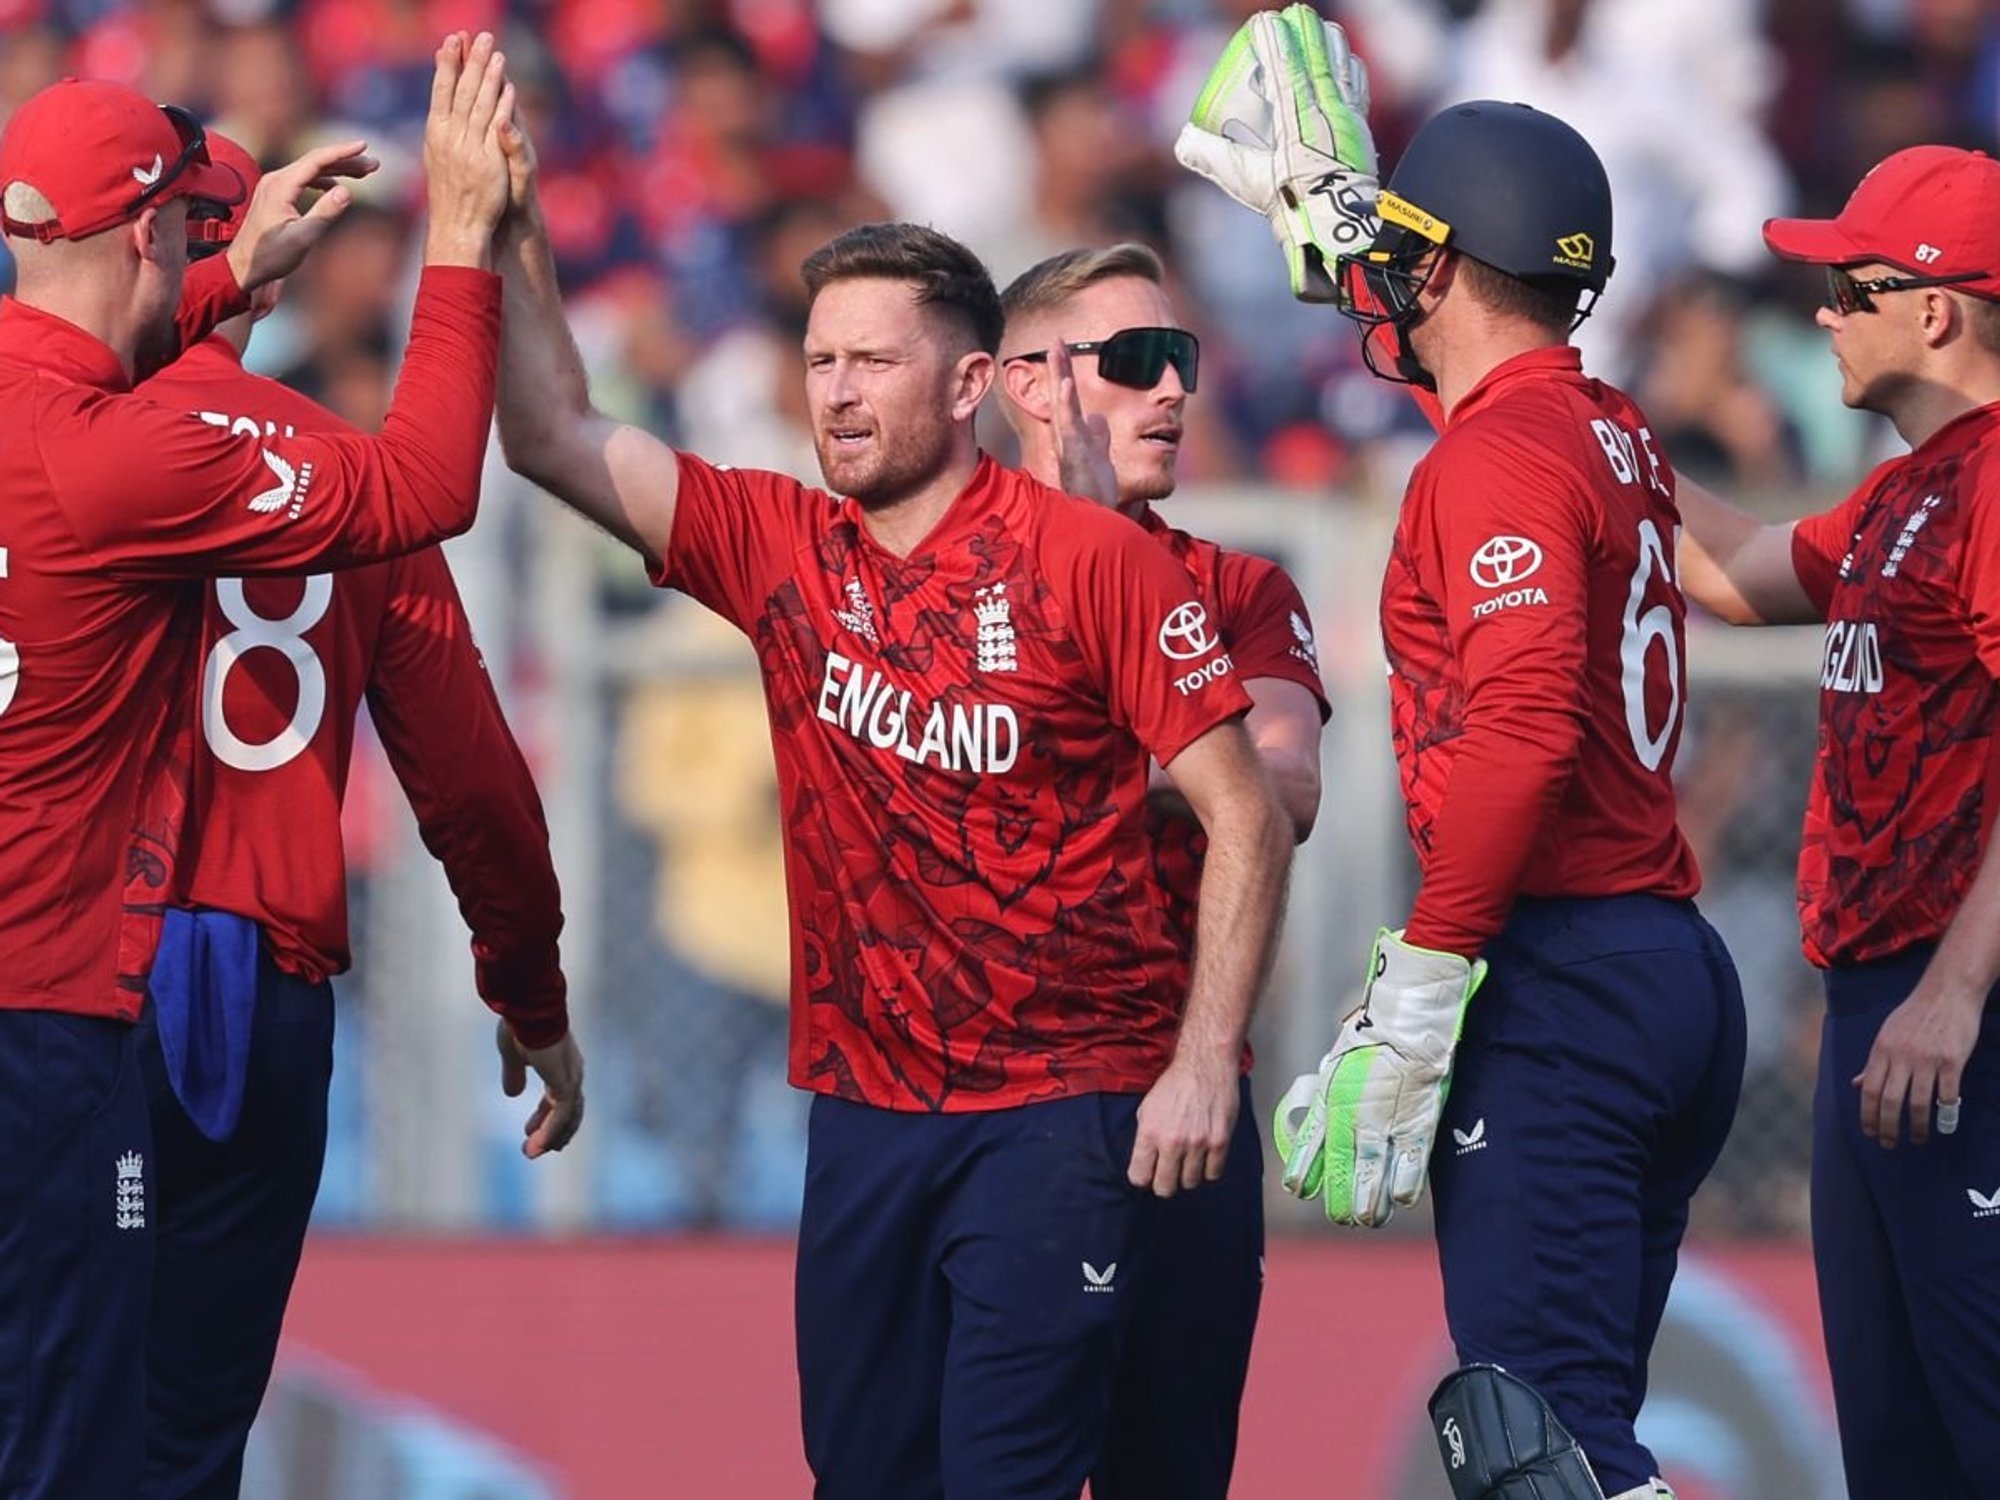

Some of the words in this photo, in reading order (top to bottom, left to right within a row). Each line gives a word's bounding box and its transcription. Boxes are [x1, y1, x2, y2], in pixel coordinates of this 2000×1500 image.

[1914, 243, 1942, 264] 87
[1471, 587, 1549, 619] TOYOTA
[1620, 518, 1684, 772] 6
[1173, 653, 1235, 696] TOYOT
[817, 651, 1020, 773] ENGLAND
